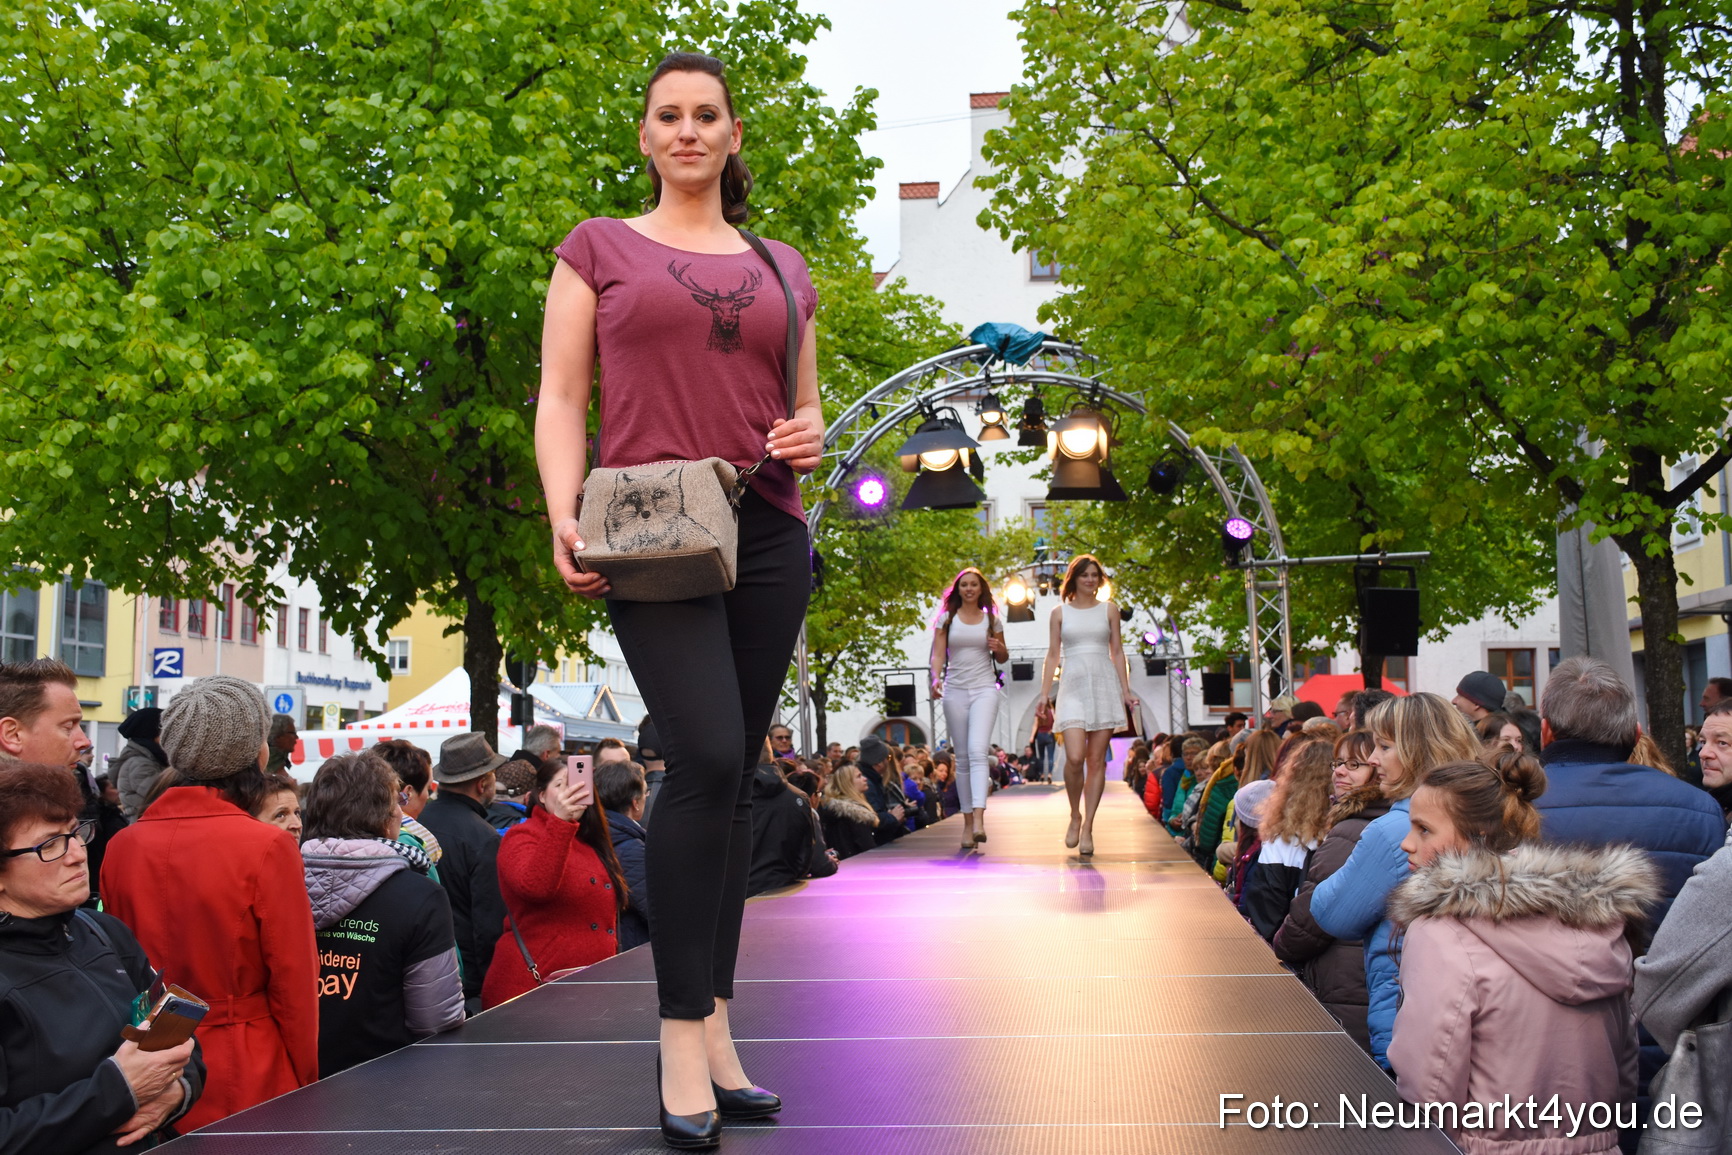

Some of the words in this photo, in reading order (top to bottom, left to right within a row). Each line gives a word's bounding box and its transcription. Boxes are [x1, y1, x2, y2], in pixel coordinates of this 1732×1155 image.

[296, 671, 342, 691] Buchhandlung
[332, 931, 345, 939] von
[346, 931, 376, 943] Wäsche
[318, 949, 361, 970] iderei
